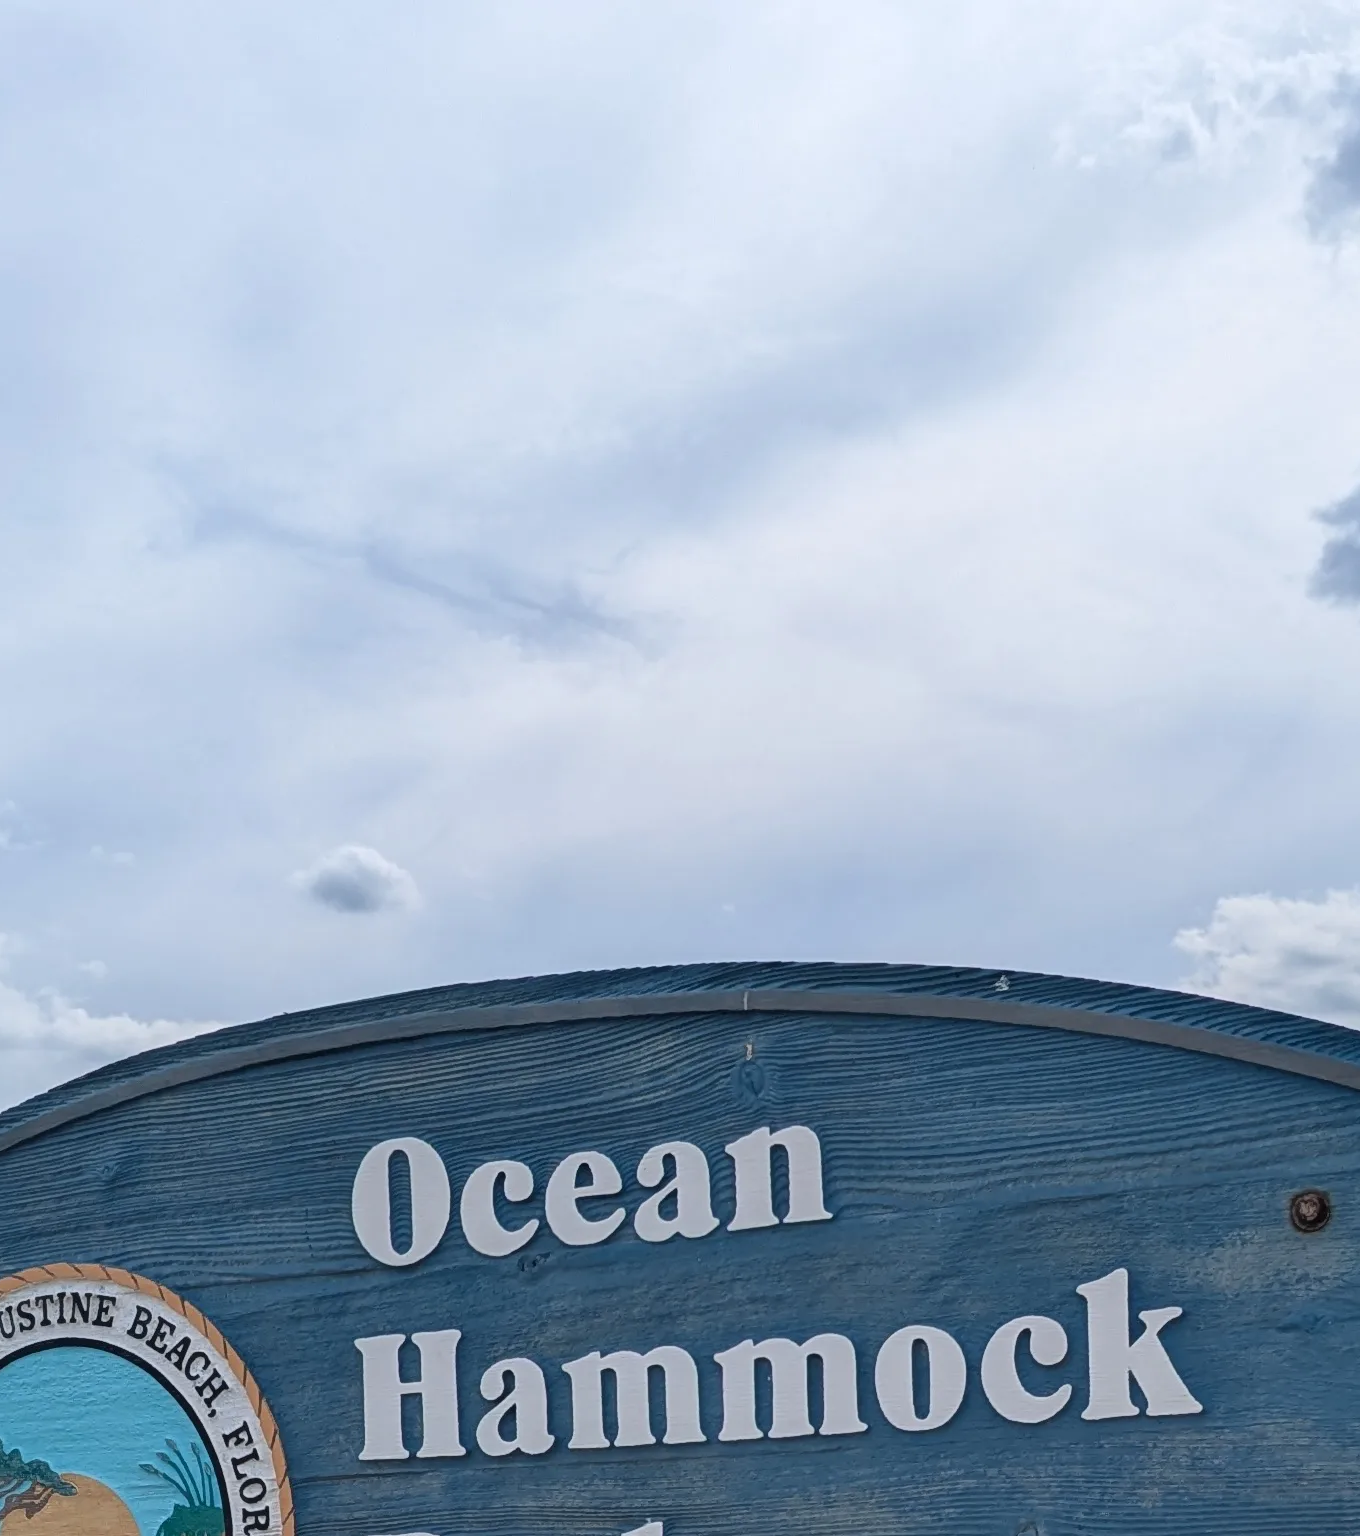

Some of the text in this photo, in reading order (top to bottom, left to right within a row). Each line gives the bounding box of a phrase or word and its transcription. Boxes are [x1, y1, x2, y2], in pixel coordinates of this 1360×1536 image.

[351, 1125, 834, 1267] Ocean
[127, 1305, 229, 1417] BEACH,
[353, 1267, 1203, 1461] Hammock
